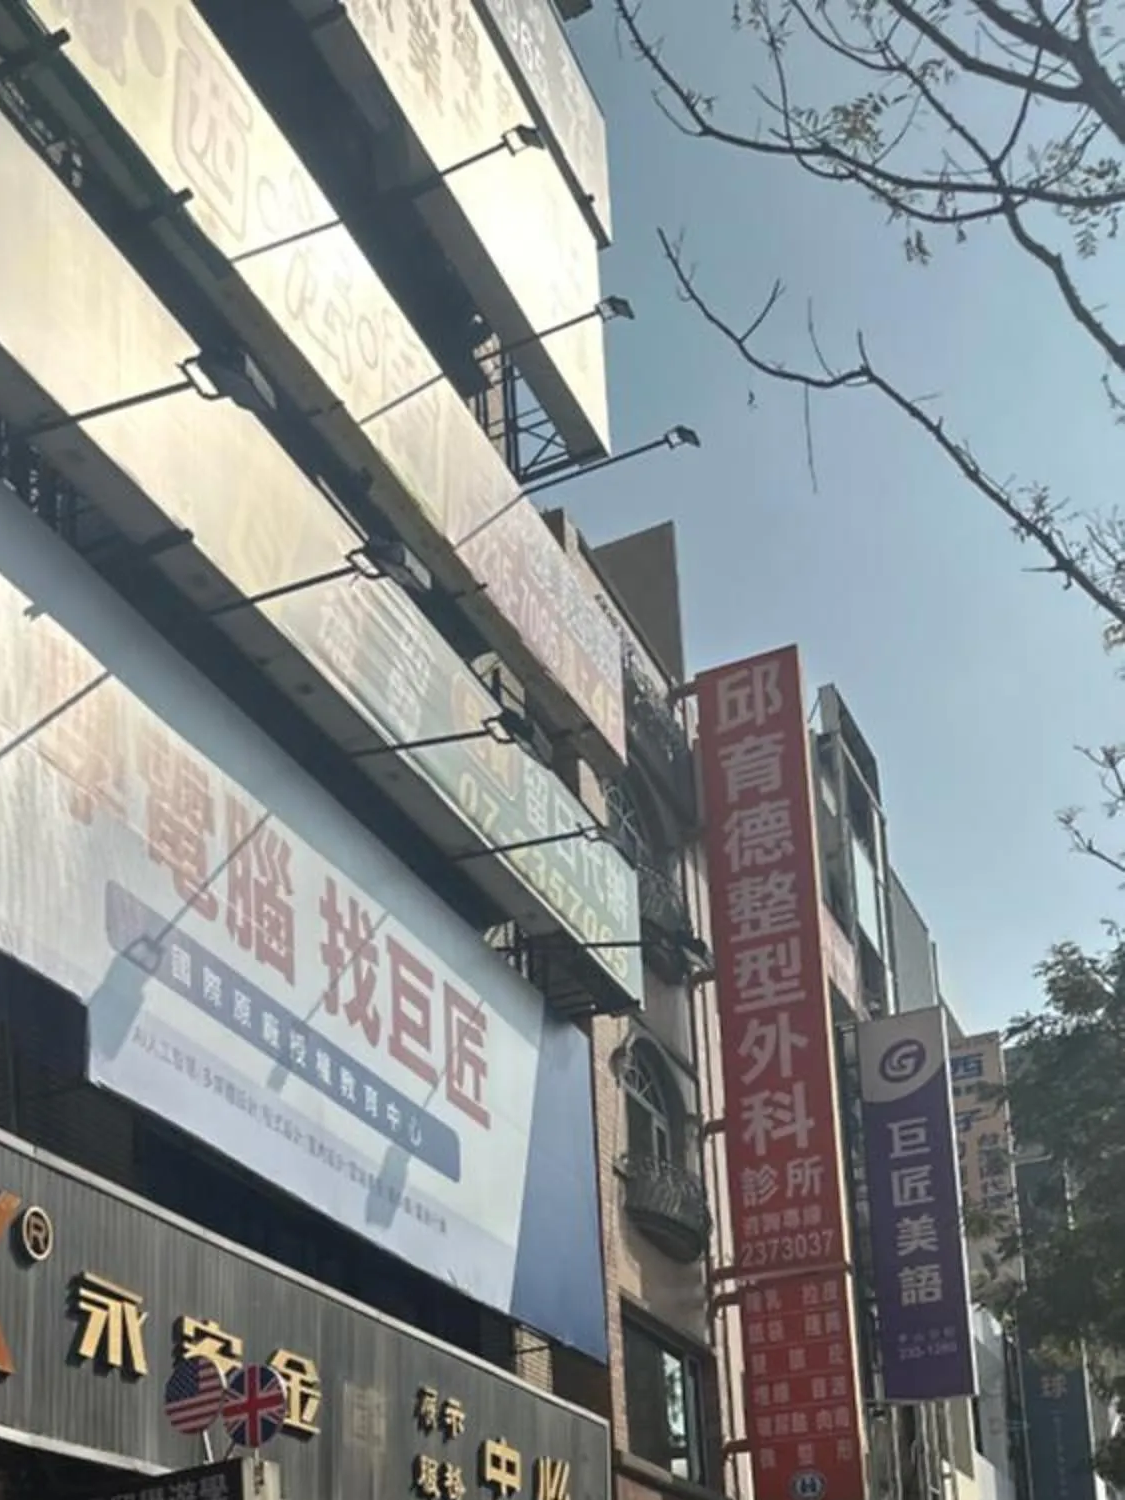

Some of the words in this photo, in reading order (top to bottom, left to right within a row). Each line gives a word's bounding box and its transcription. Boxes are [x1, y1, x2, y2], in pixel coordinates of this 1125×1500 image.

[318, 874, 492, 1131] 找巨匠
[715, 659, 820, 1155] 邱育德整型外科
[741, 1155, 824, 1208] 診所
[741, 1228, 836, 1269] 2373037
[886, 1116, 944, 1307] 巨匠美語
